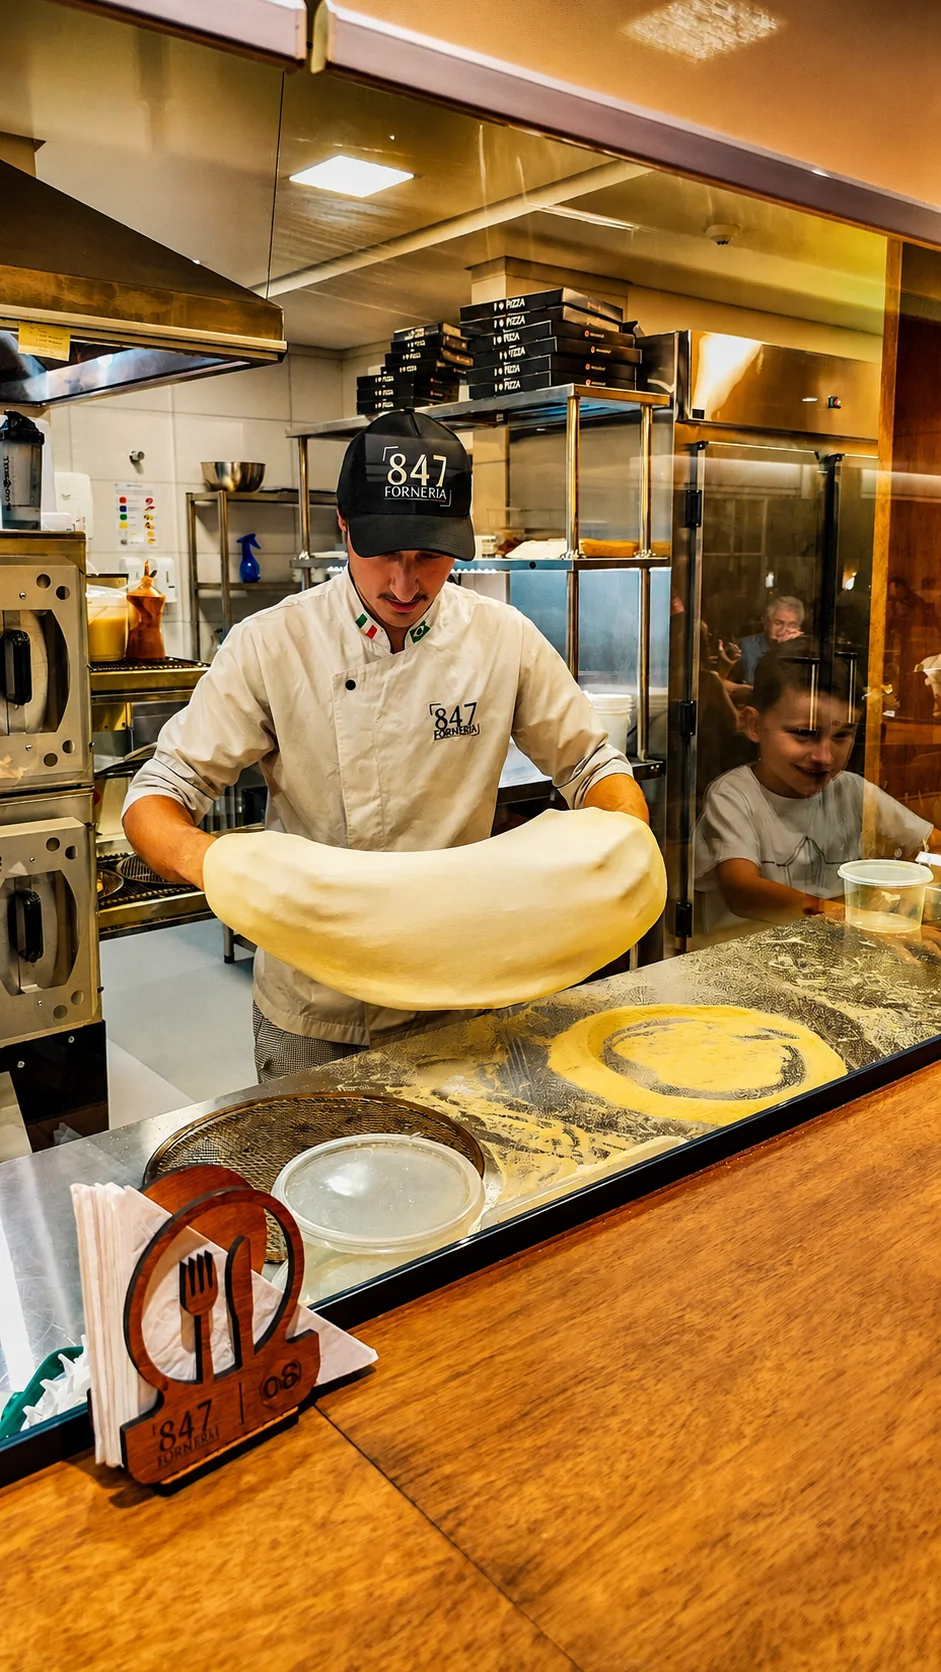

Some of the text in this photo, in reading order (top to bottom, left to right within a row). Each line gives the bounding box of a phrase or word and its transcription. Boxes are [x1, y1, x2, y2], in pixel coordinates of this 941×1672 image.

[506, 298, 525, 309] PIZZA
[506, 315, 525, 327] PIZZA
[387, 453, 447, 487] 847
[384, 486, 447, 499] FORNERIA
[435, 702, 477, 730] 847
[434, 724, 477, 740] FORNERIA
[159, 1399, 212, 1451] 847
